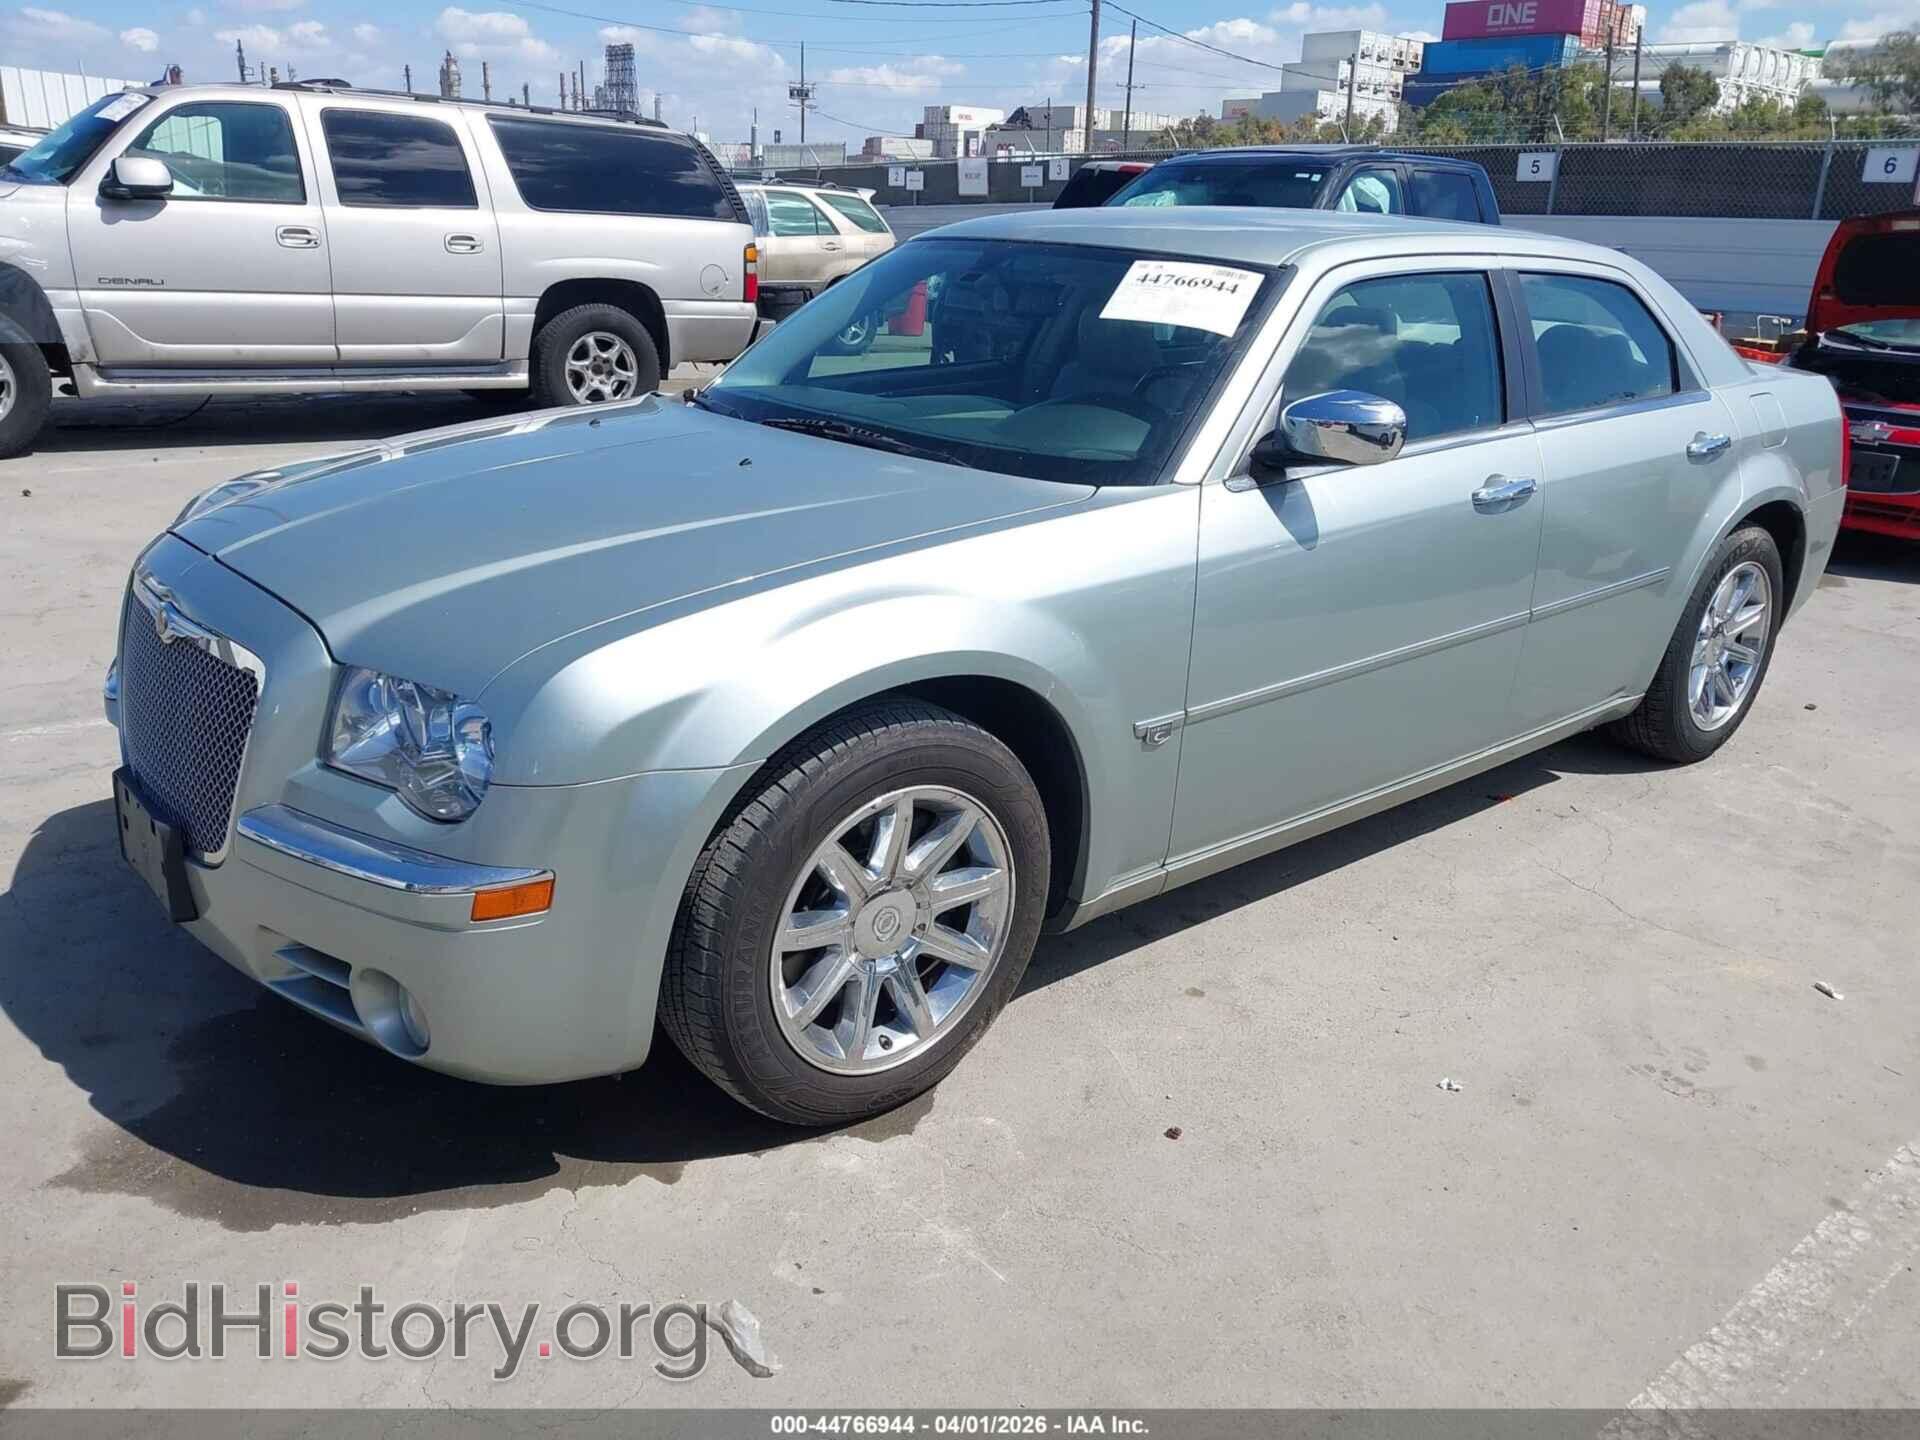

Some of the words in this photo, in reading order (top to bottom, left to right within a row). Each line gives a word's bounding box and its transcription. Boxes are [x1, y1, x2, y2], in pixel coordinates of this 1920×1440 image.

[1486, 2, 1538, 26] ONE
[1055, 163, 1063, 177] 3
[1530, 159, 1540, 175] 5
[1884, 156, 1898, 175] 6
[97, 276, 165, 286] DENALI
[1136, 272, 1240, 294] 44766944
